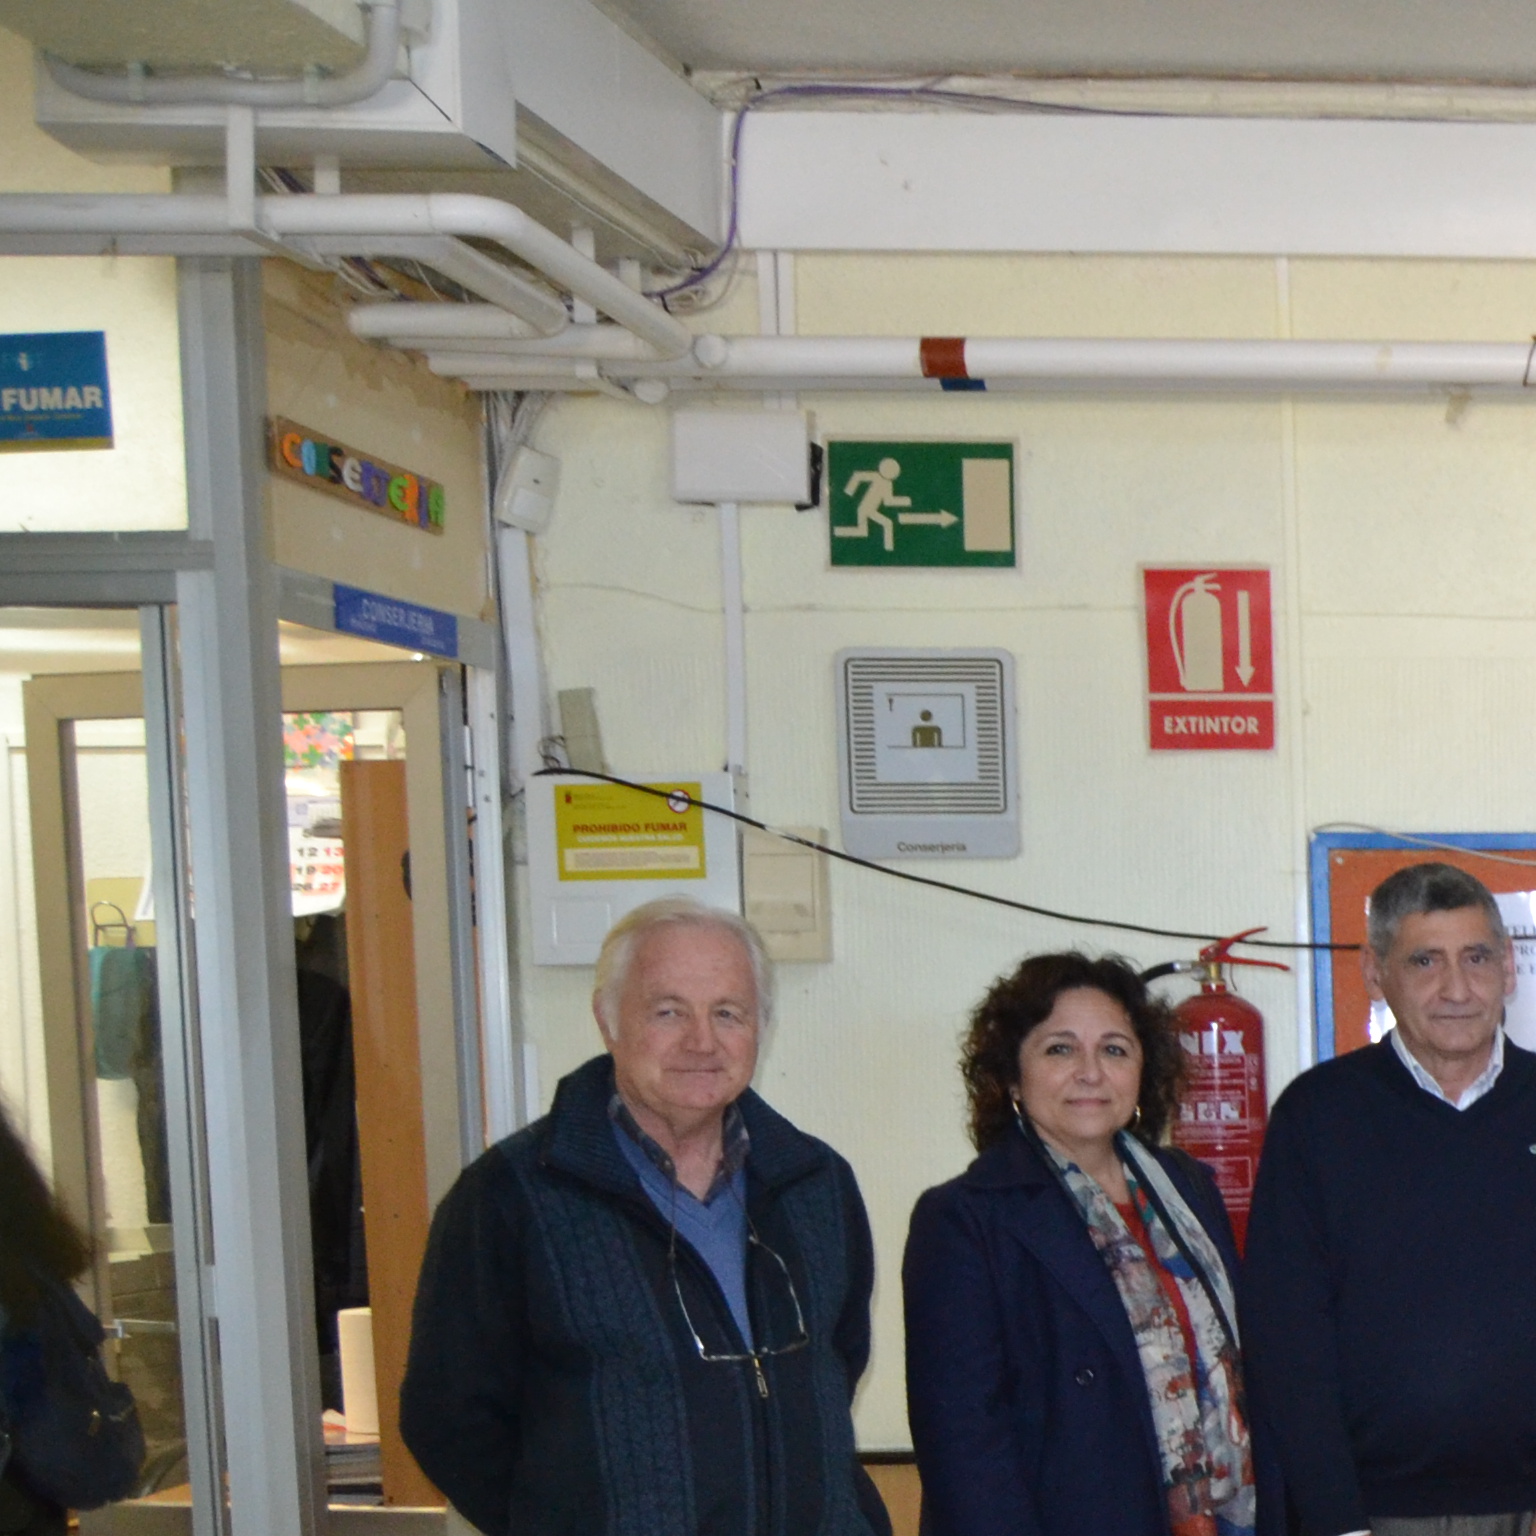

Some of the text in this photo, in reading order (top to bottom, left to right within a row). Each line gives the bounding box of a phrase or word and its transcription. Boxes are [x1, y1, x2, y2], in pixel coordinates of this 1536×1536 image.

[2, 386, 103, 411] FUMAR
[1163, 714, 1260, 735] EXTINTOR
[573, 822, 688, 833] PROHIBIDO FUMAR
